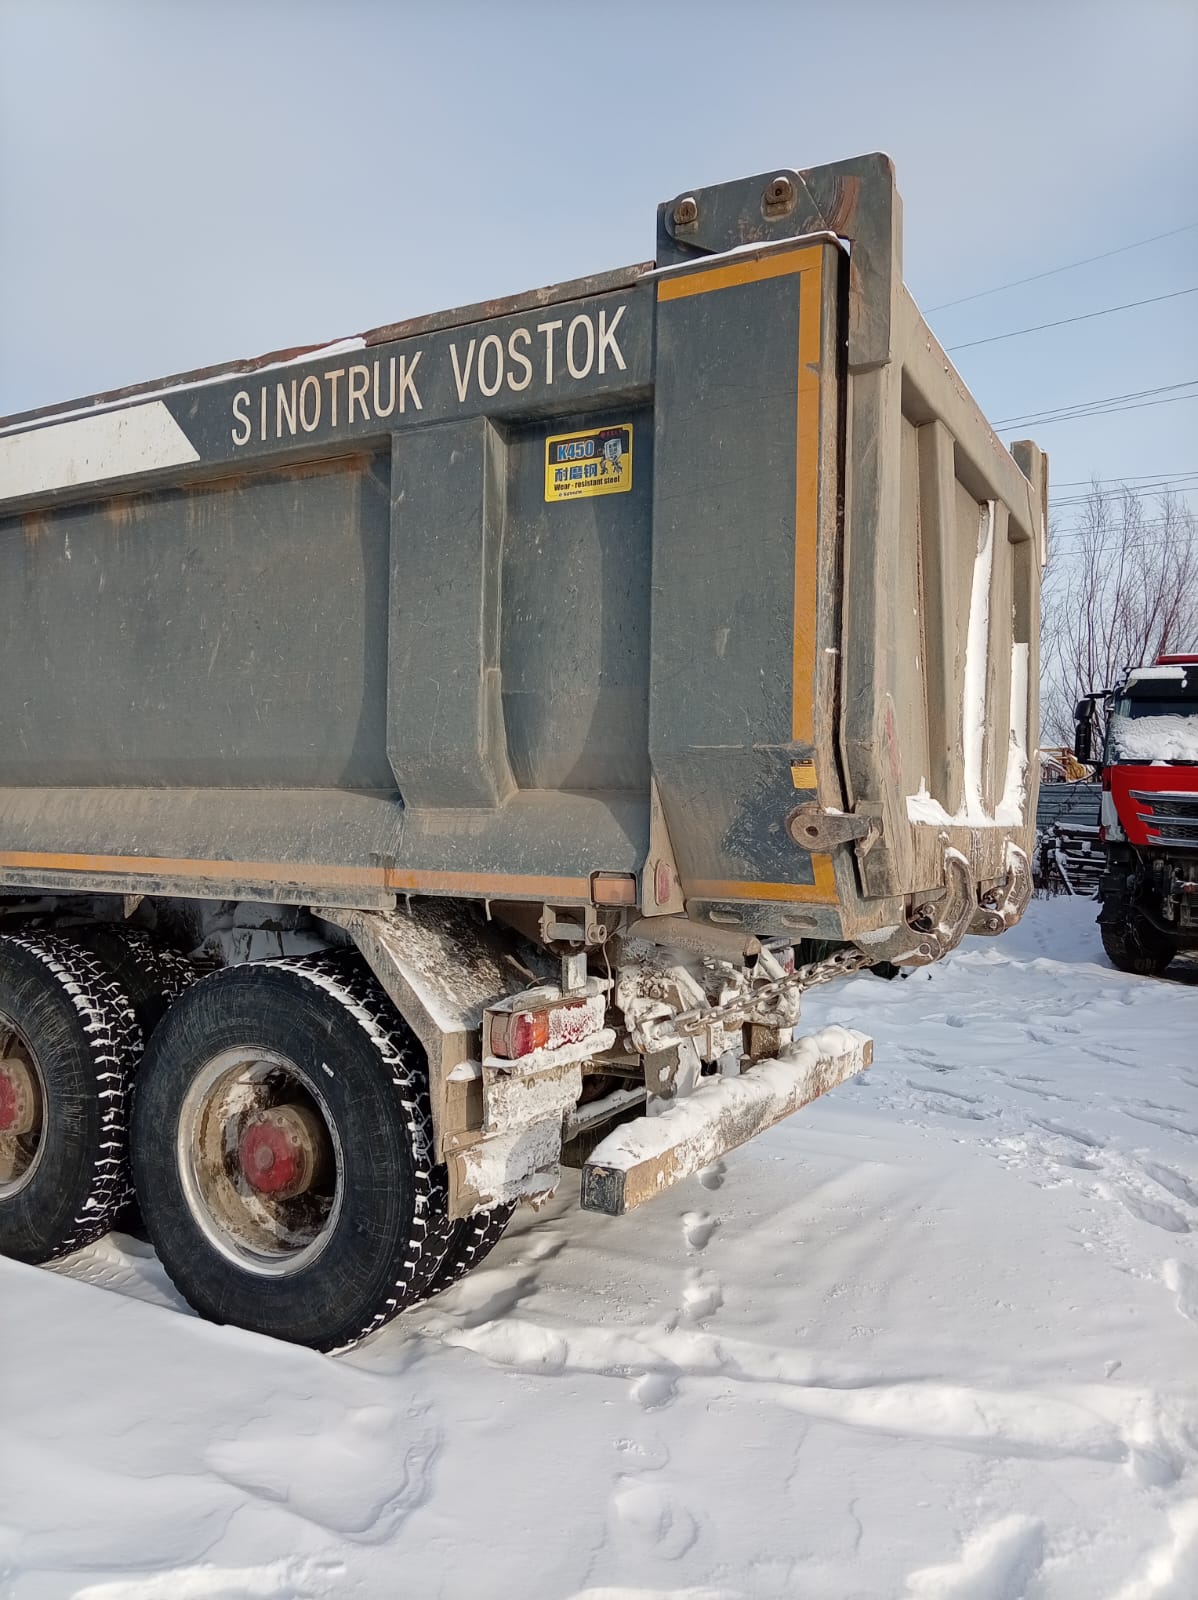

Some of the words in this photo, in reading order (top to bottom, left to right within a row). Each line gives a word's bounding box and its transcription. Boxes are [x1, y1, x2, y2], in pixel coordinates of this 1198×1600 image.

[231, 350, 424, 447] SINOTRUK
[449, 305, 628, 403] VOSTOK
[557, 440, 595, 462] K450
[555, 463, 598, 482] 耐磨钢
[604, 475, 620, 484] steel
